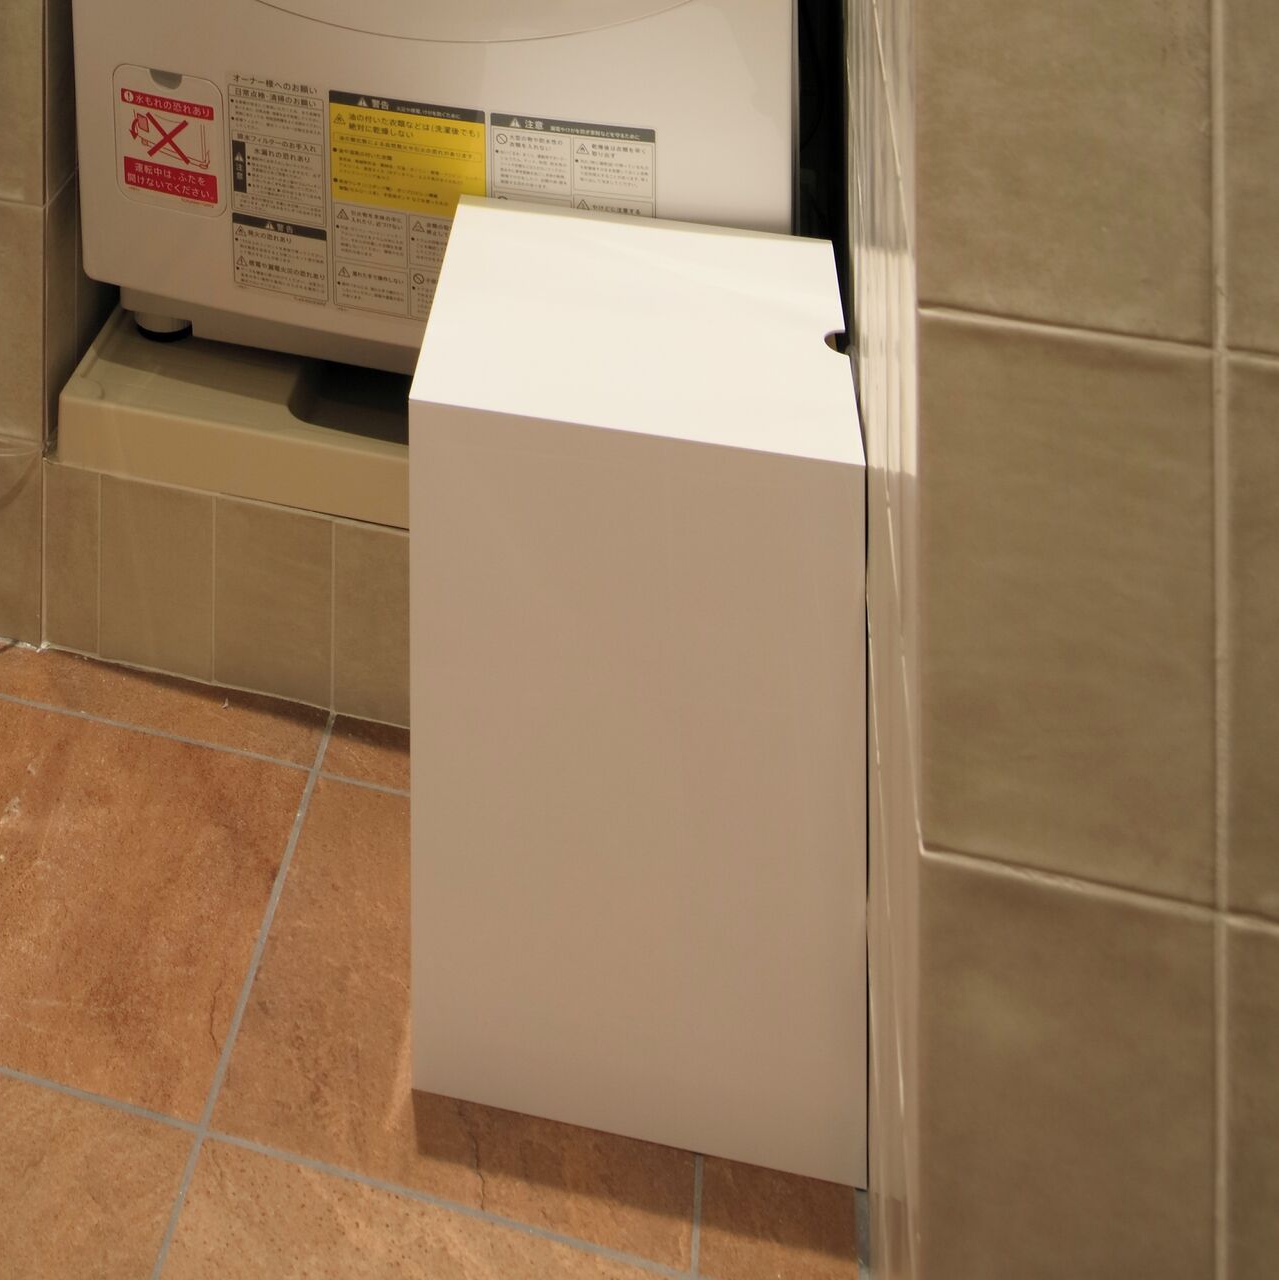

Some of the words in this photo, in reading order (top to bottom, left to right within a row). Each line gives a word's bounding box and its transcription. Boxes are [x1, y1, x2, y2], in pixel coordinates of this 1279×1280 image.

[233, 74, 318, 95] オーナー様へのお願い
[136, 95, 210, 118] 水もれの恐れあり
[371, 98, 390, 111] 警告
[348, 113, 481, 138] 油の付いた衣類などは(洗濯後でも)
[348, 123, 414, 138] 絶対に乾燥しない
[525, 120, 544, 129] 注意
[135, 162, 207, 186] 運転中は、ふたを
[127, 173, 214, 200] 開けないでください。
